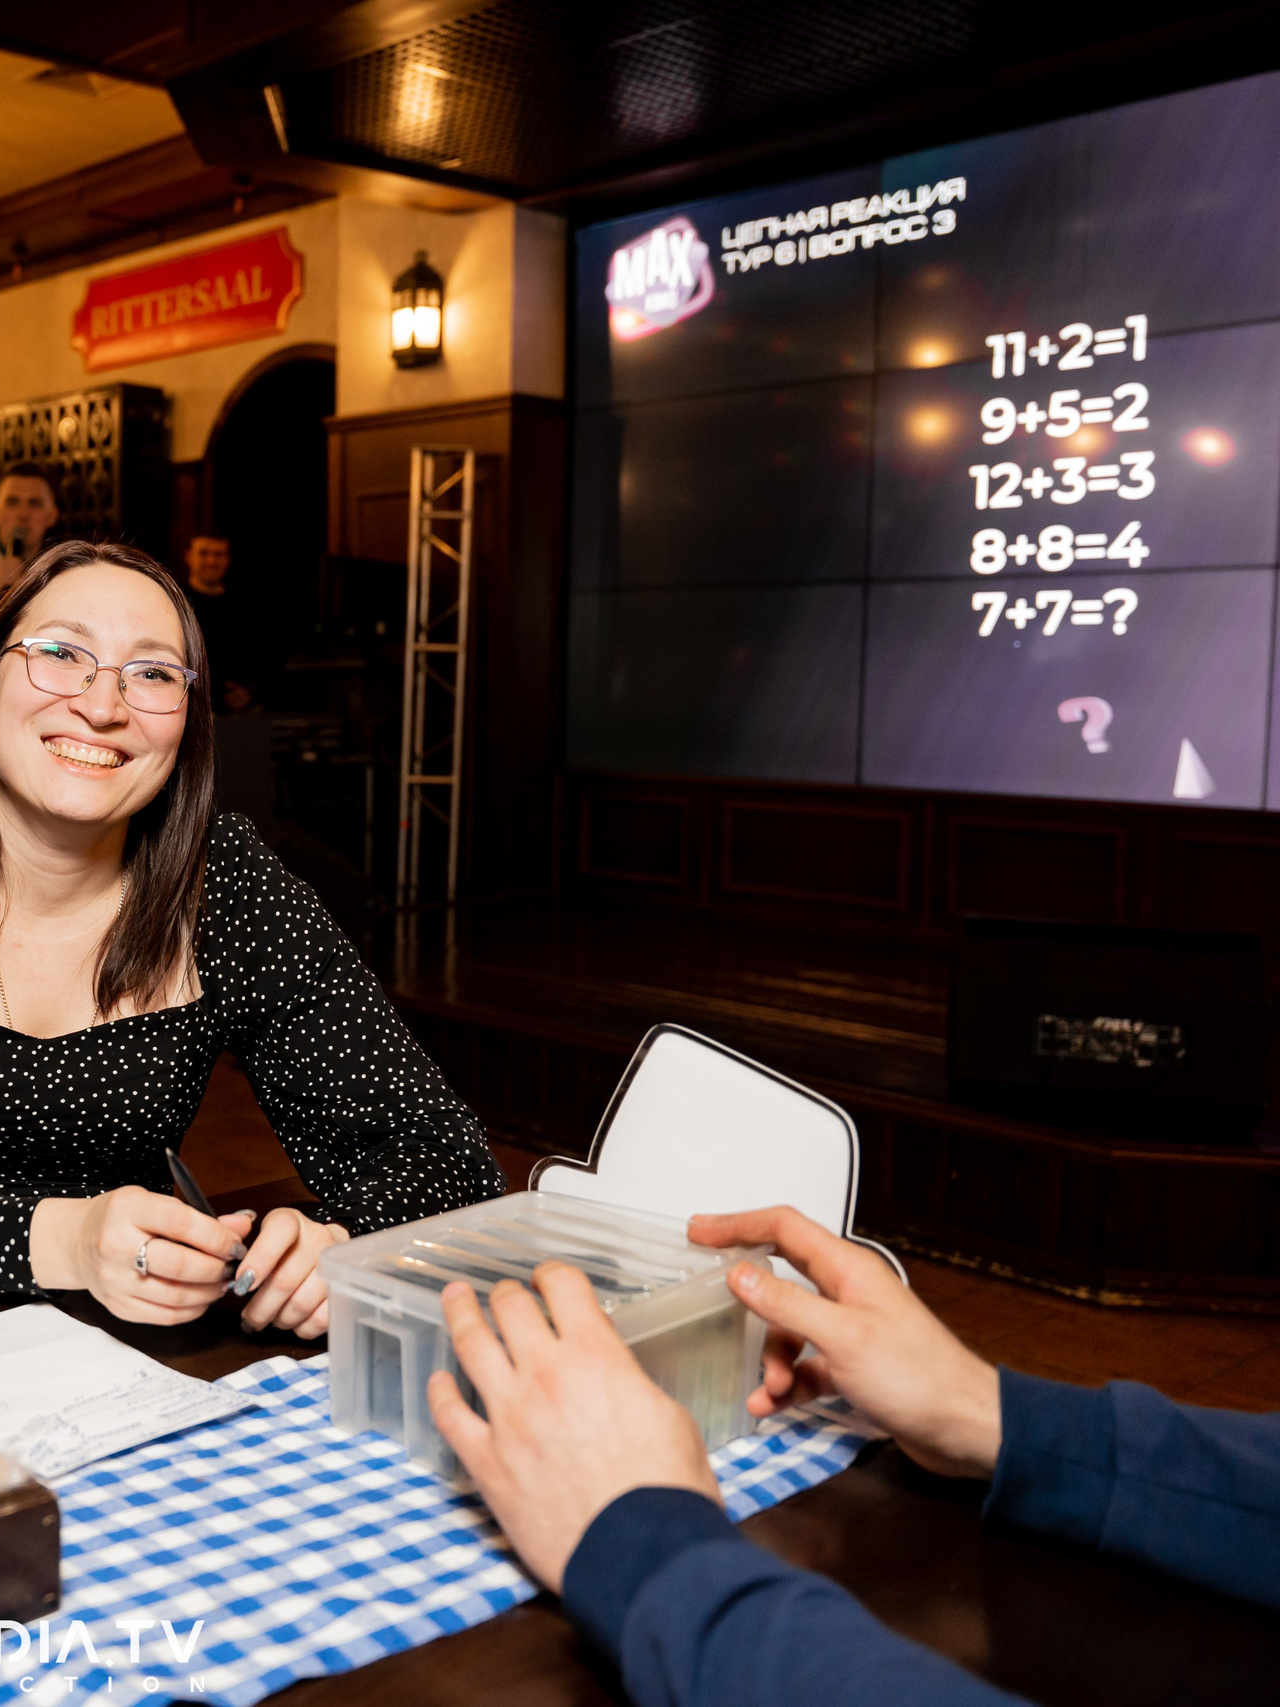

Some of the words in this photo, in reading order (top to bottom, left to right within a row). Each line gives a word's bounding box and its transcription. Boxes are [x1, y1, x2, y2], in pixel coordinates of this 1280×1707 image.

[721, 204, 829, 250] ЦЕПНАЯ
[830, 176, 967, 228] РЕАКЦИЯ
[721, 244, 773, 275] ТУР
[773, 239, 797, 266] 6
[808, 213, 929, 260] ВОПРОС
[932, 208, 957, 236] 3
[613, 227, 697, 301] MAX
[89, 264, 273, 341] RITTERSAAL
[985, 314, 1148, 379] 11+2=1
[980, 382, 1150, 445] 9+5=2
[968, 451, 1156, 511] 12+3=3
[969, 520, 1150, 575] 8+8=4
[971, 587, 1139, 637] 7+7=?
